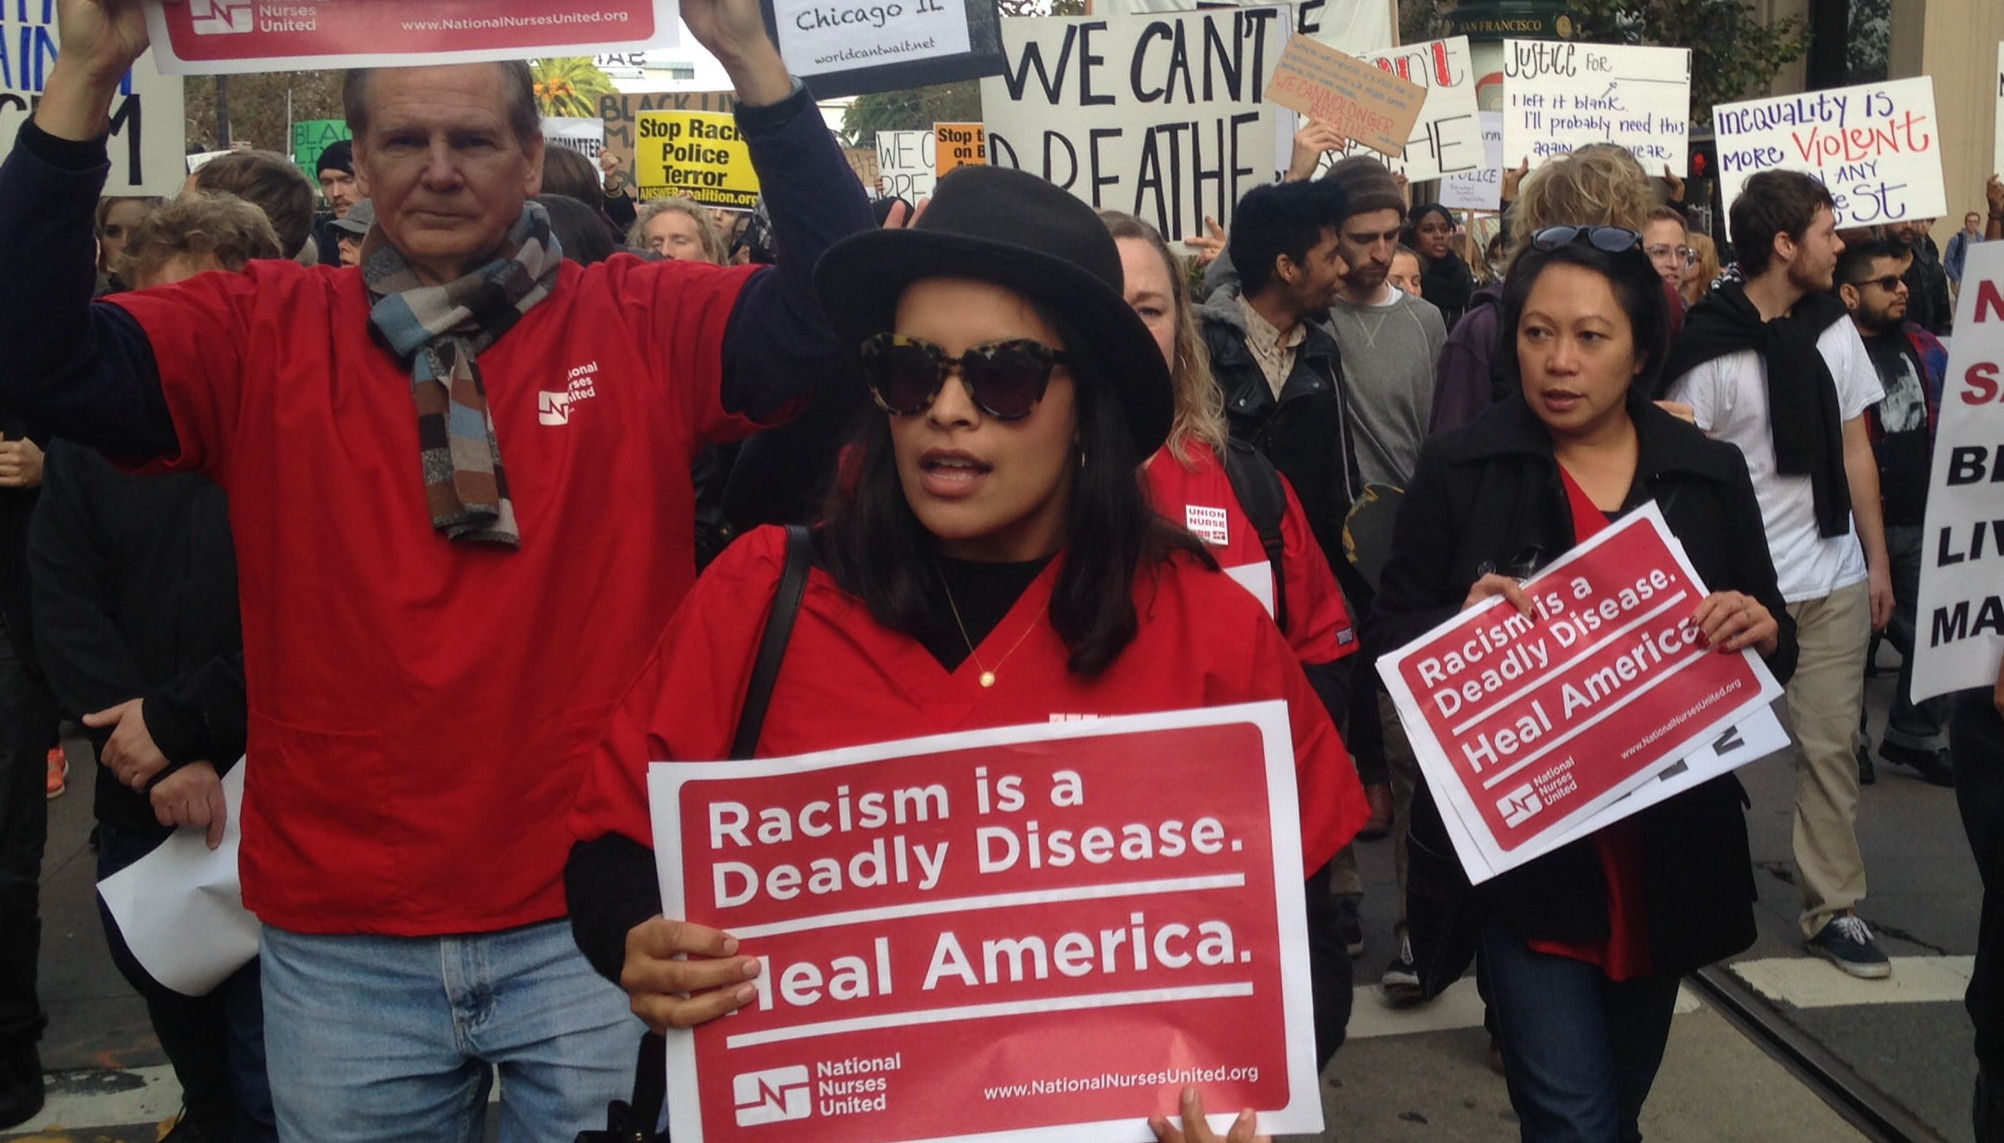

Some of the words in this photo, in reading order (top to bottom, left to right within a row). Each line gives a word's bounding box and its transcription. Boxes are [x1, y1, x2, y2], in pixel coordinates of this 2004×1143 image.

[258, 3, 317, 18] Nurses
[401, 10, 629, 31] www.NationalNursesUnited.org
[796, 2, 902, 31] Chicago
[915, 0, 944, 14] IL
[260, 18, 317, 33] United
[1479, 19, 1542, 32] FRANCISCO
[814, 37, 936, 65] worldcantwait.net
[1000, 21, 1115, 107] WE
[1127, 8, 1277, 105] CAN'T
[1522, 93, 1545, 108] left
[1552, 95, 1567, 109] it
[640, 119, 681, 141] Stop
[689, 119, 744, 141] Raci
[938, 128, 972, 145] Stop
[1550, 114, 1611, 141] probably
[1619, 112, 1651, 135] need
[1659, 117, 1685, 135] this
[663, 143, 729, 165] Police
[877, 132, 914, 169] WE
[954, 146, 972, 159] on
[663, 165, 728, 187] Terror
[1188, 508, 1225, 518] UNION
[1189, 518, 1225, 528] NURSE
[1416, 610, 1535, 690] Racism
[1532, 588, 1565, 621] is
[1572, 574, 1594, 600] a
[1432, 637, 1550, 719] Deadly
[1548, 565, 1677, 649] Disease.
[1620, 677, 1743, 761] www.NationalNursesUnited.org
[1460, 700, 1554, 774] Heal
[1532, 756, 1576, 788] National
[1537, 771, 1574, 799] Nurses
[1542, 780, 1579, 807] United
[707, 782, 950, 850] Racism
[975, 766, 1026, 815] is
[1050, 768, 1085, 807] a
[711, 835, 950, 909] Deadly
[976, 816, 1243, 875] Disease.
[922, 912, 1252, 991] America.
[815, 1052, 902, 1078] National
[818, 1075, 888, 1099] Nurses
[983, 1064, 1260, 1101] www.NationalNursesUnited.org
[819, 1094, 887, 1119] United
